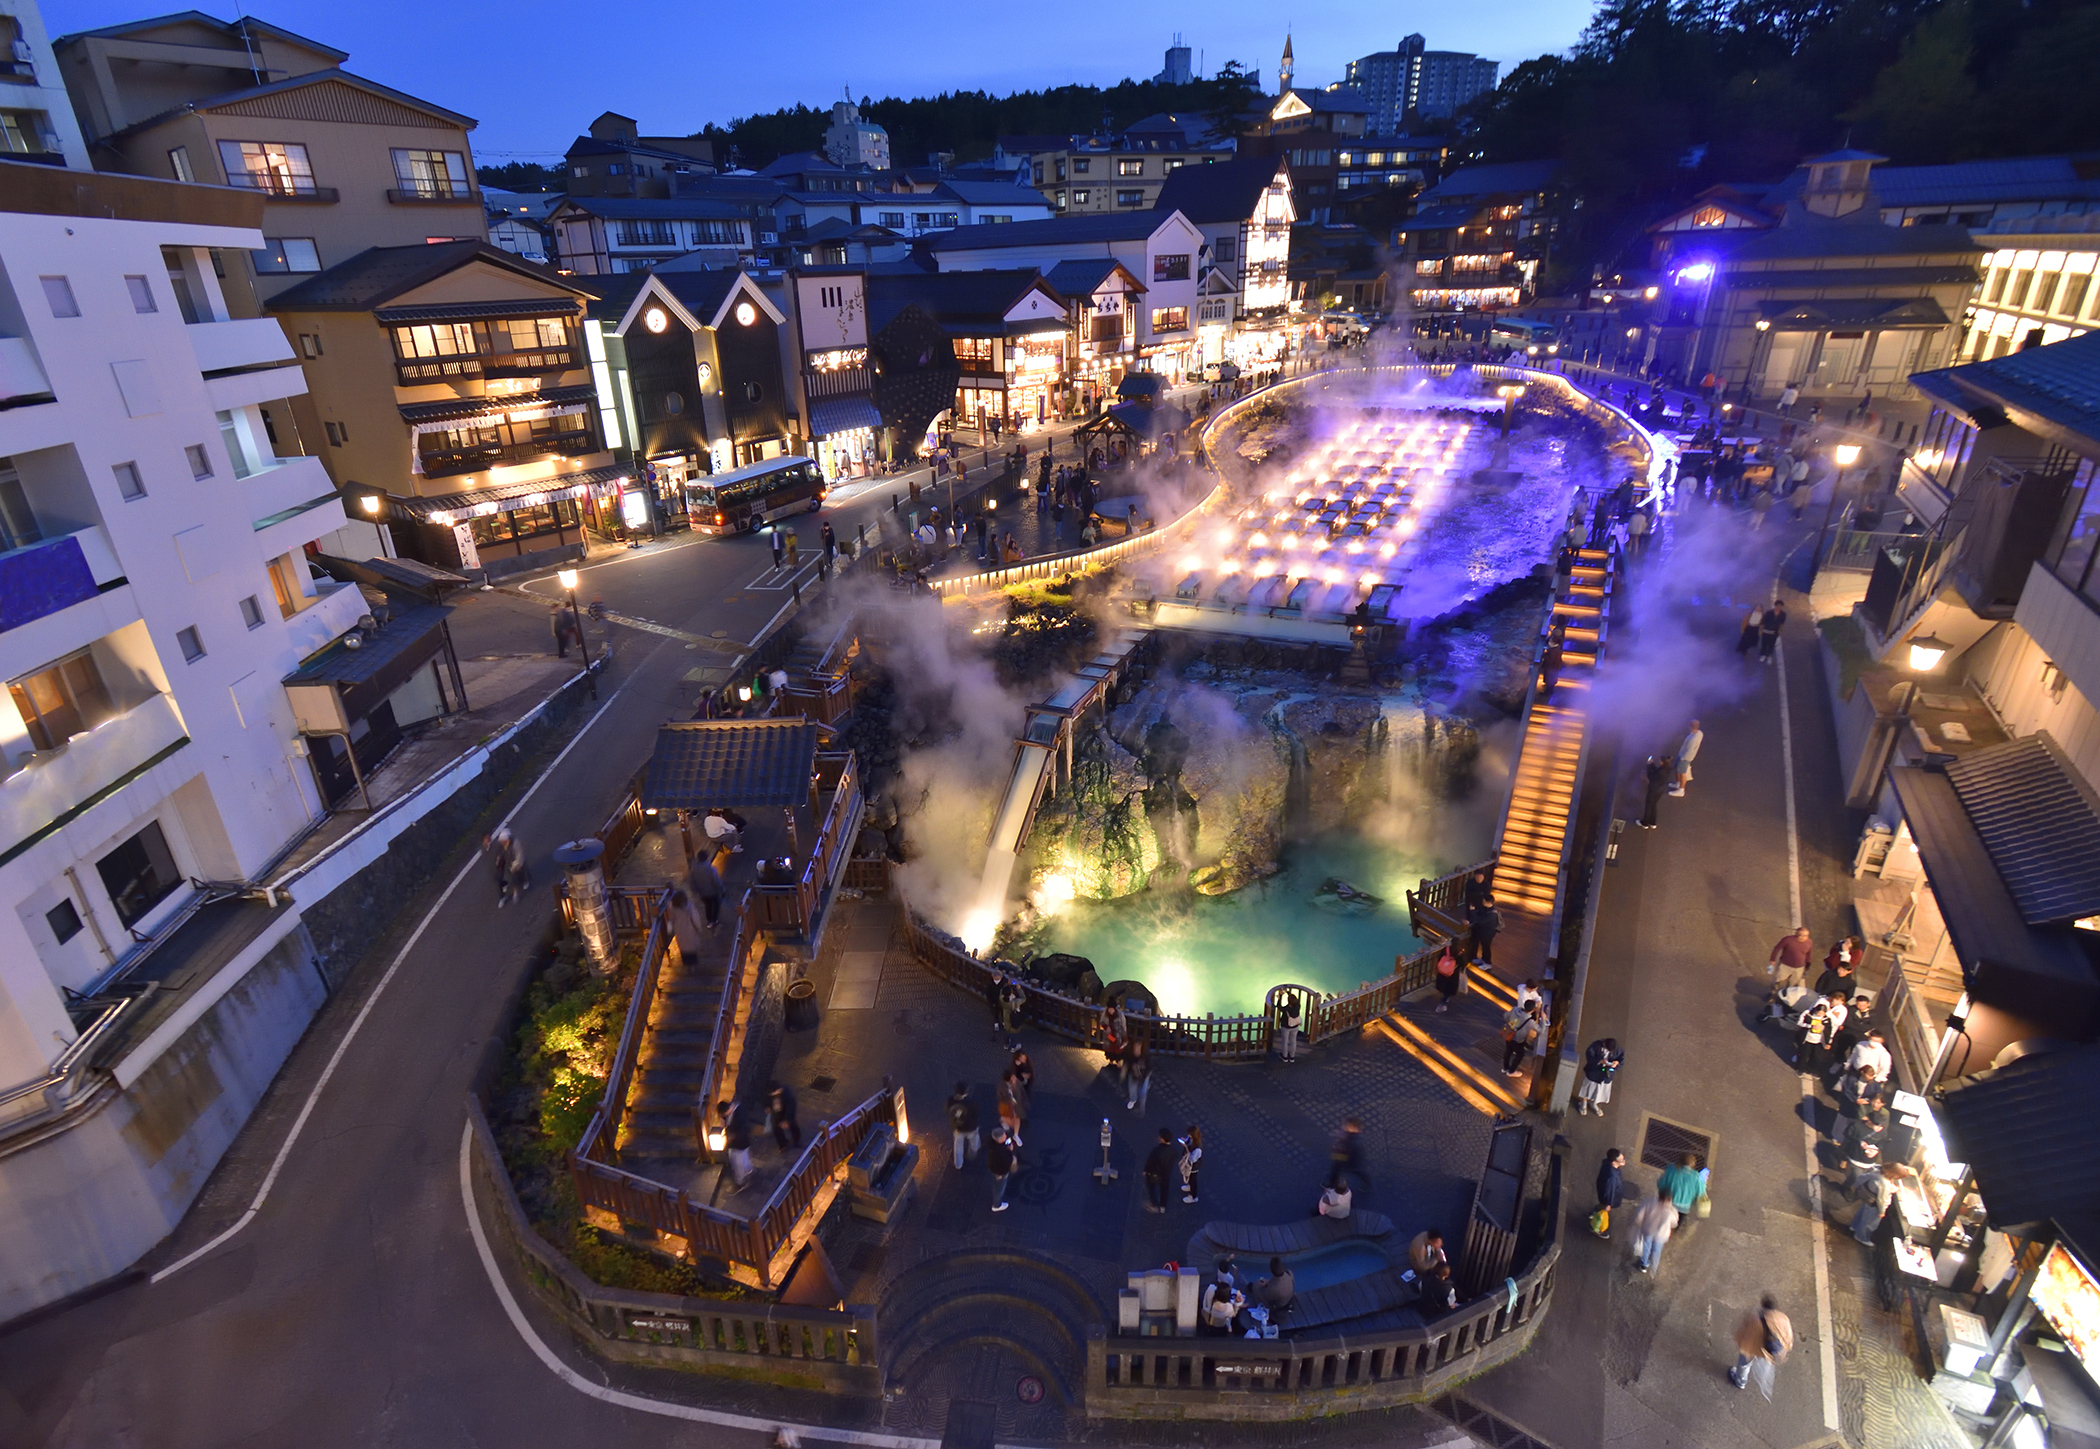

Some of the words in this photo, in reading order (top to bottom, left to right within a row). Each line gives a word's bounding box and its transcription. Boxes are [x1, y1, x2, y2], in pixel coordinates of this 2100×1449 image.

[1097, 302, 1120, 314] ちちや
[1234, 1366, 1251, 1374] 東京
[1254, 1366, 1281, 1375] 軽井沢
